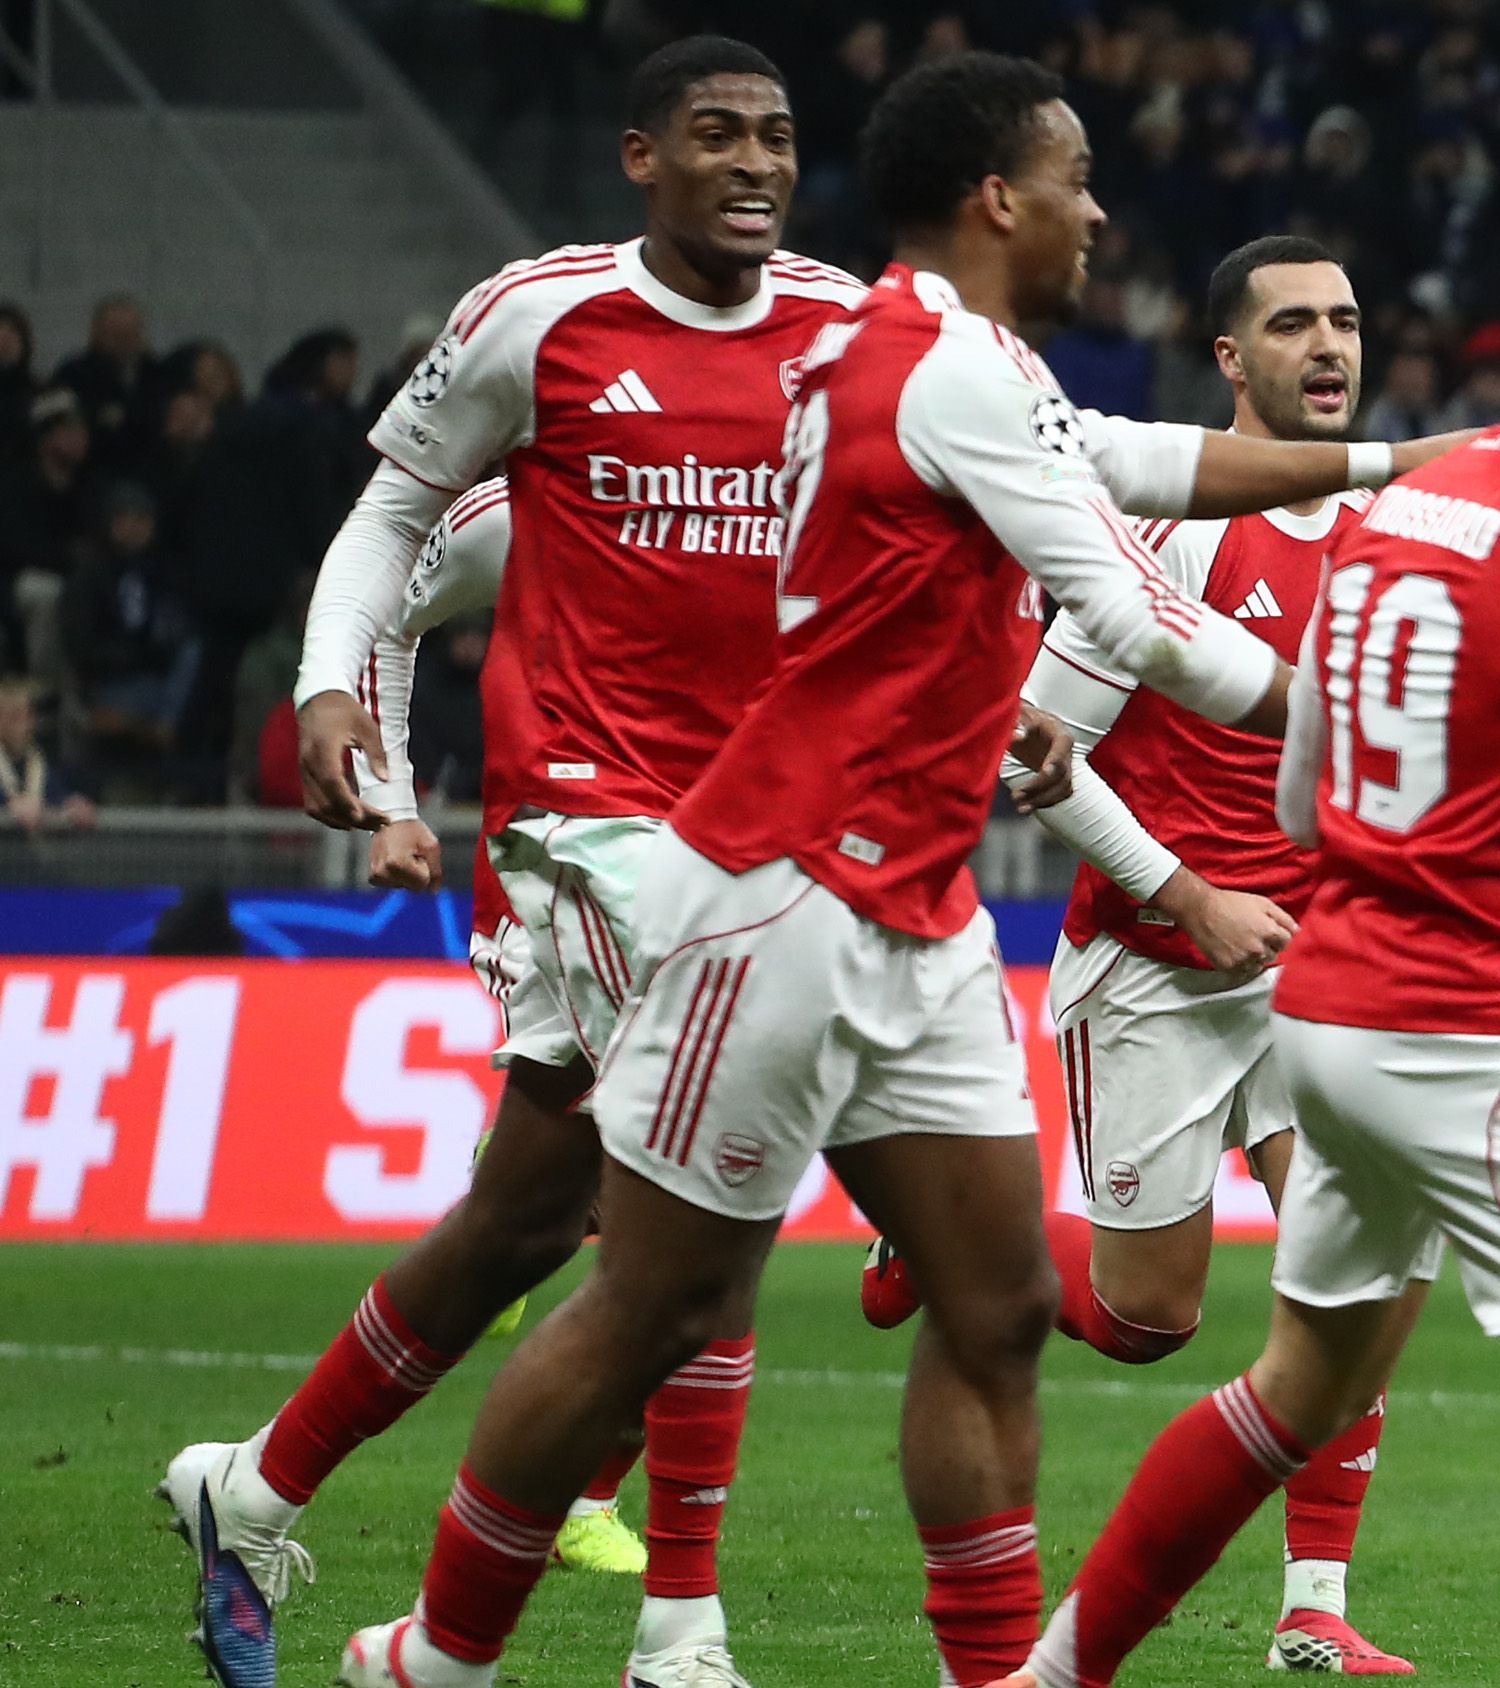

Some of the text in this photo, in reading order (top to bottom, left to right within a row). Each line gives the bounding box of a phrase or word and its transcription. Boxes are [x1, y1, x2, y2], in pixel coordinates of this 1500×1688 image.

[618, 509, 785, 558] FLY BETTER
[1326, 561, 1464, 834] 19
[0, 974, 241, 1223] #1
